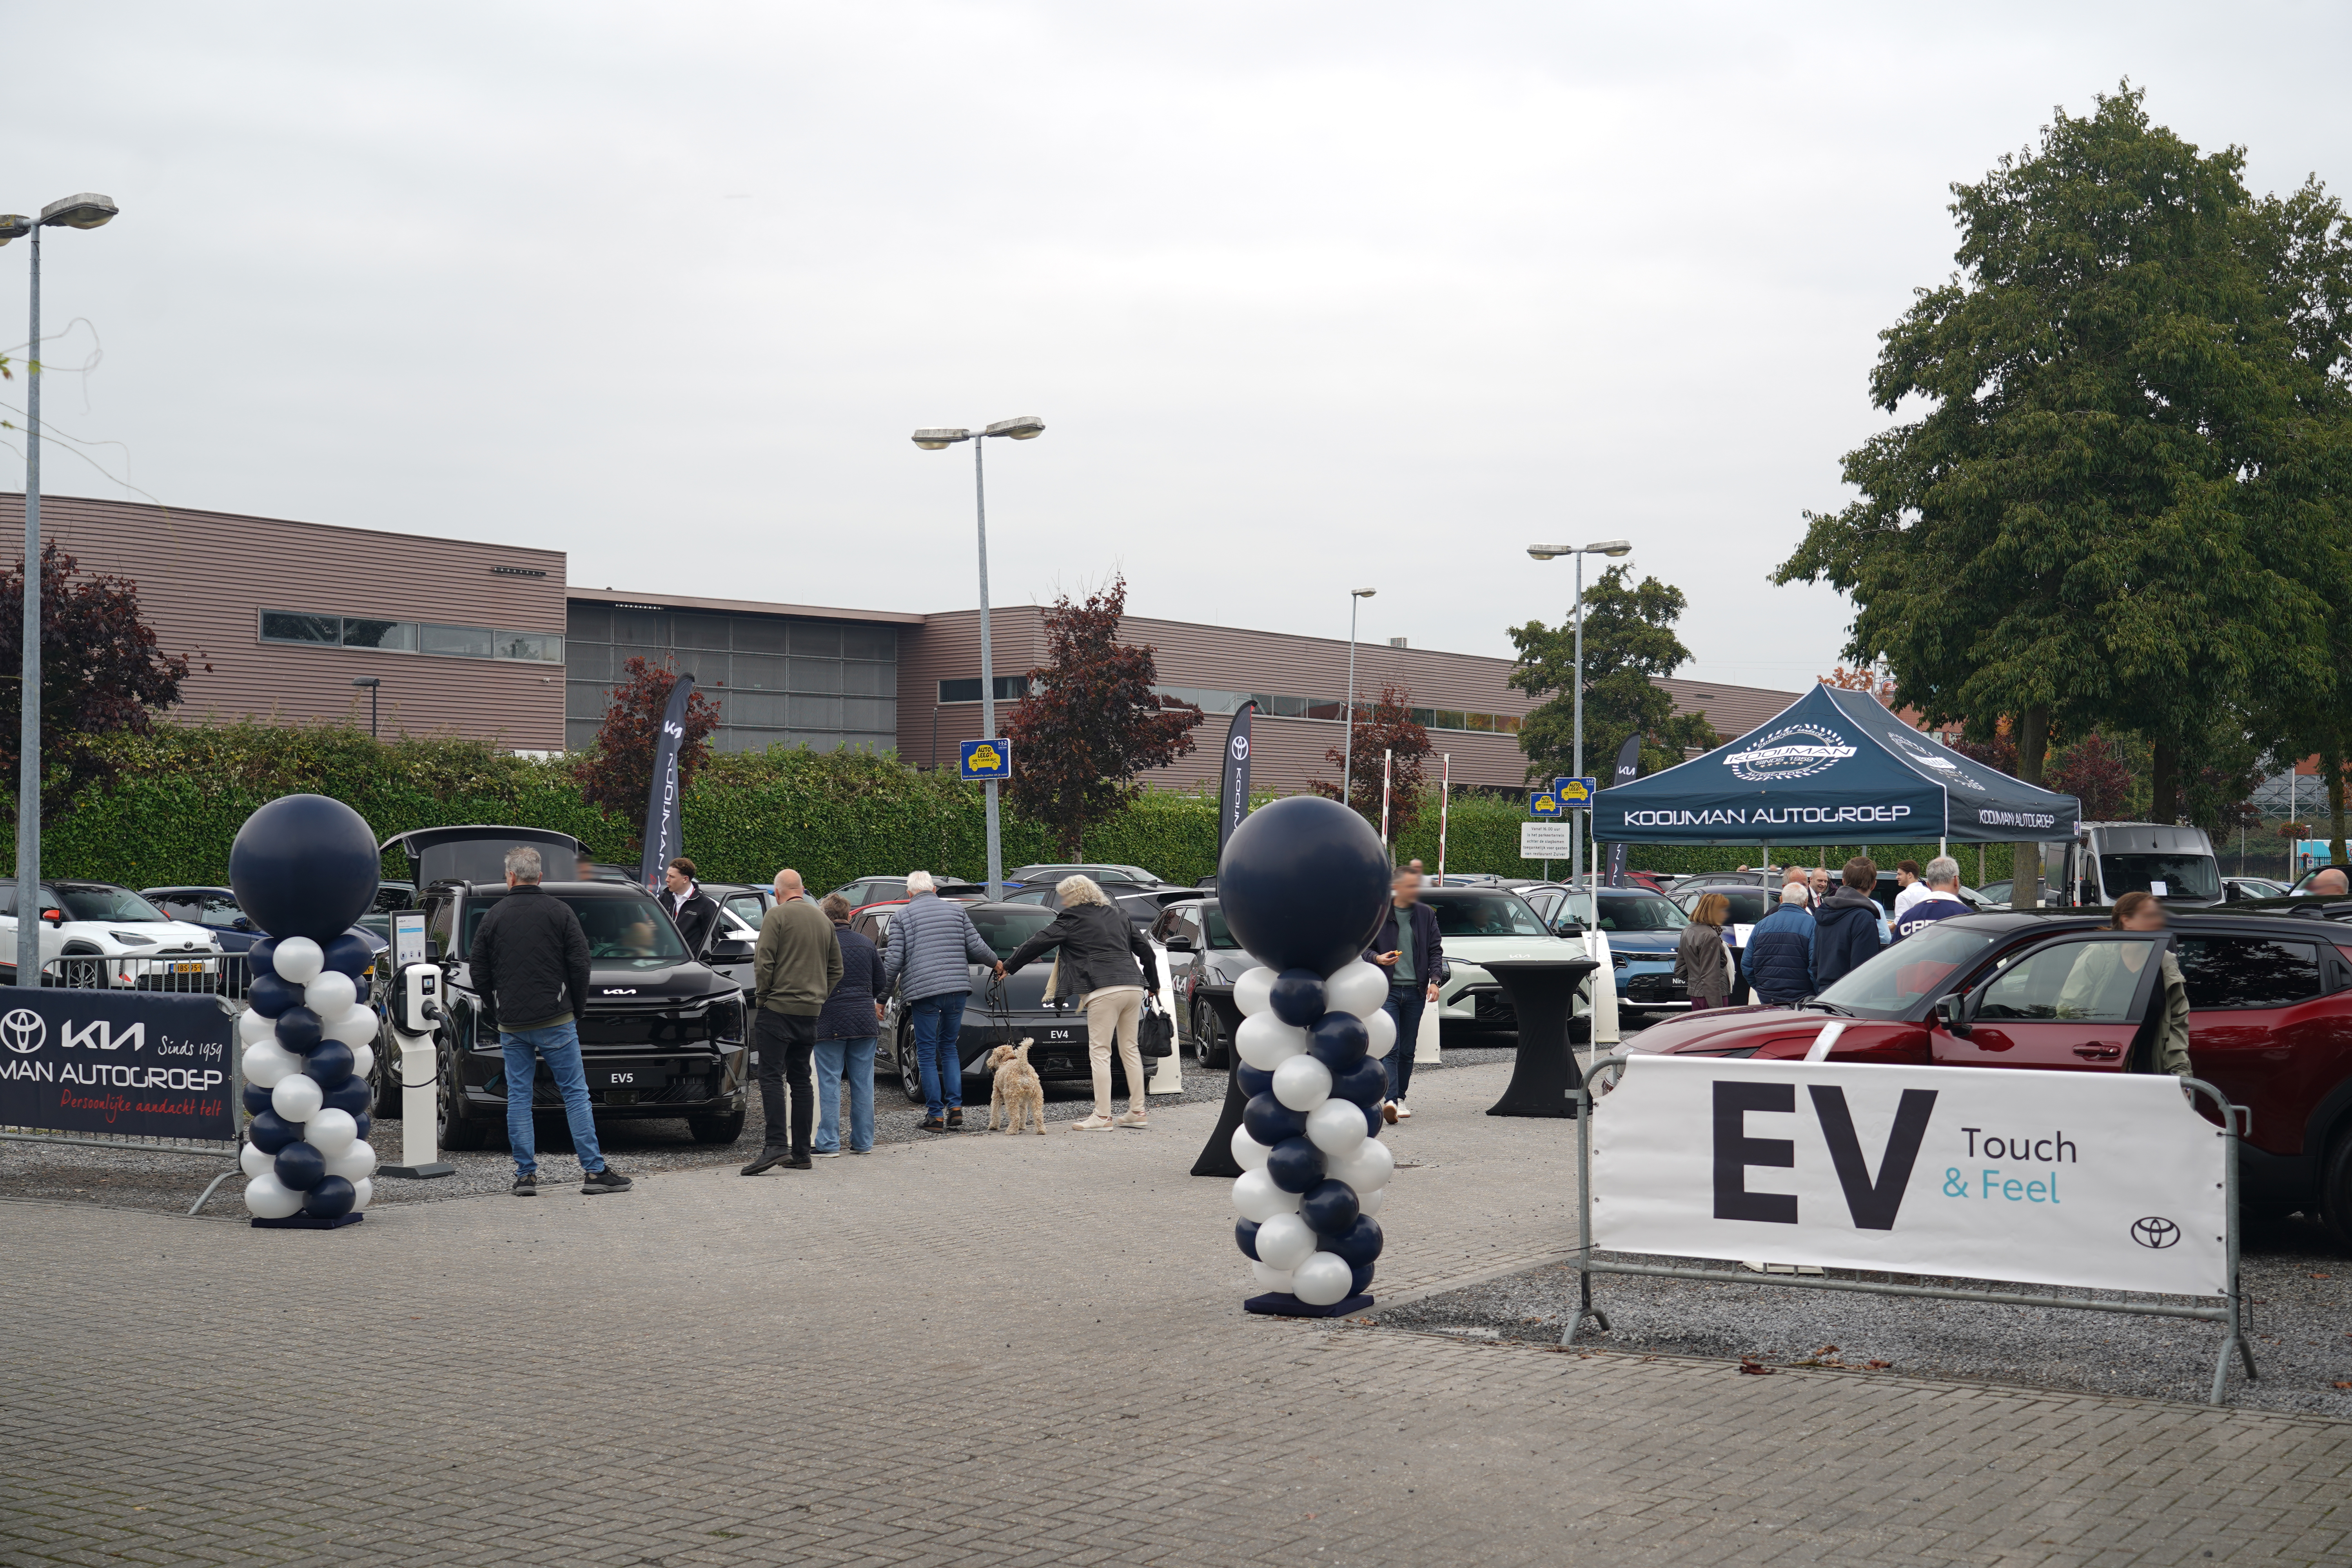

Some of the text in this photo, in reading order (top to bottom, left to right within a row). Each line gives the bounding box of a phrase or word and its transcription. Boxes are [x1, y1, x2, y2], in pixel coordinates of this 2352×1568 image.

[664, 720, 682, 739] KA
[1730, 747, 1851, 762] KOOIJMAN
[1755, 757, 1785, 765] SINDS
[1746, 768, 1811, 778] AUTOGROEP
[1234, 768, 1242, 831] KOOIJM
[1624, 806, 1911, 826] KOOIJMAN AUTOGROEP
[1978, 809, 2054, 828] KOOIJMAN AUTOGROEP
[1051, 1030, 1069, 1038] EV4
[158, 1035, 223, 1062] Sinds 1959
[59, 1063, 223, 1091] AUTOGROEP
[611, 1073, 633, 1083] EV5
[61, 1089, 222, 1123] Persoonlijke aandacht telt
[1961, 1127, 2077, 1163] Touch
[1712, 1080, 1939, 1231] EV
[1942, 1167, 2060, 1205] & Feel
